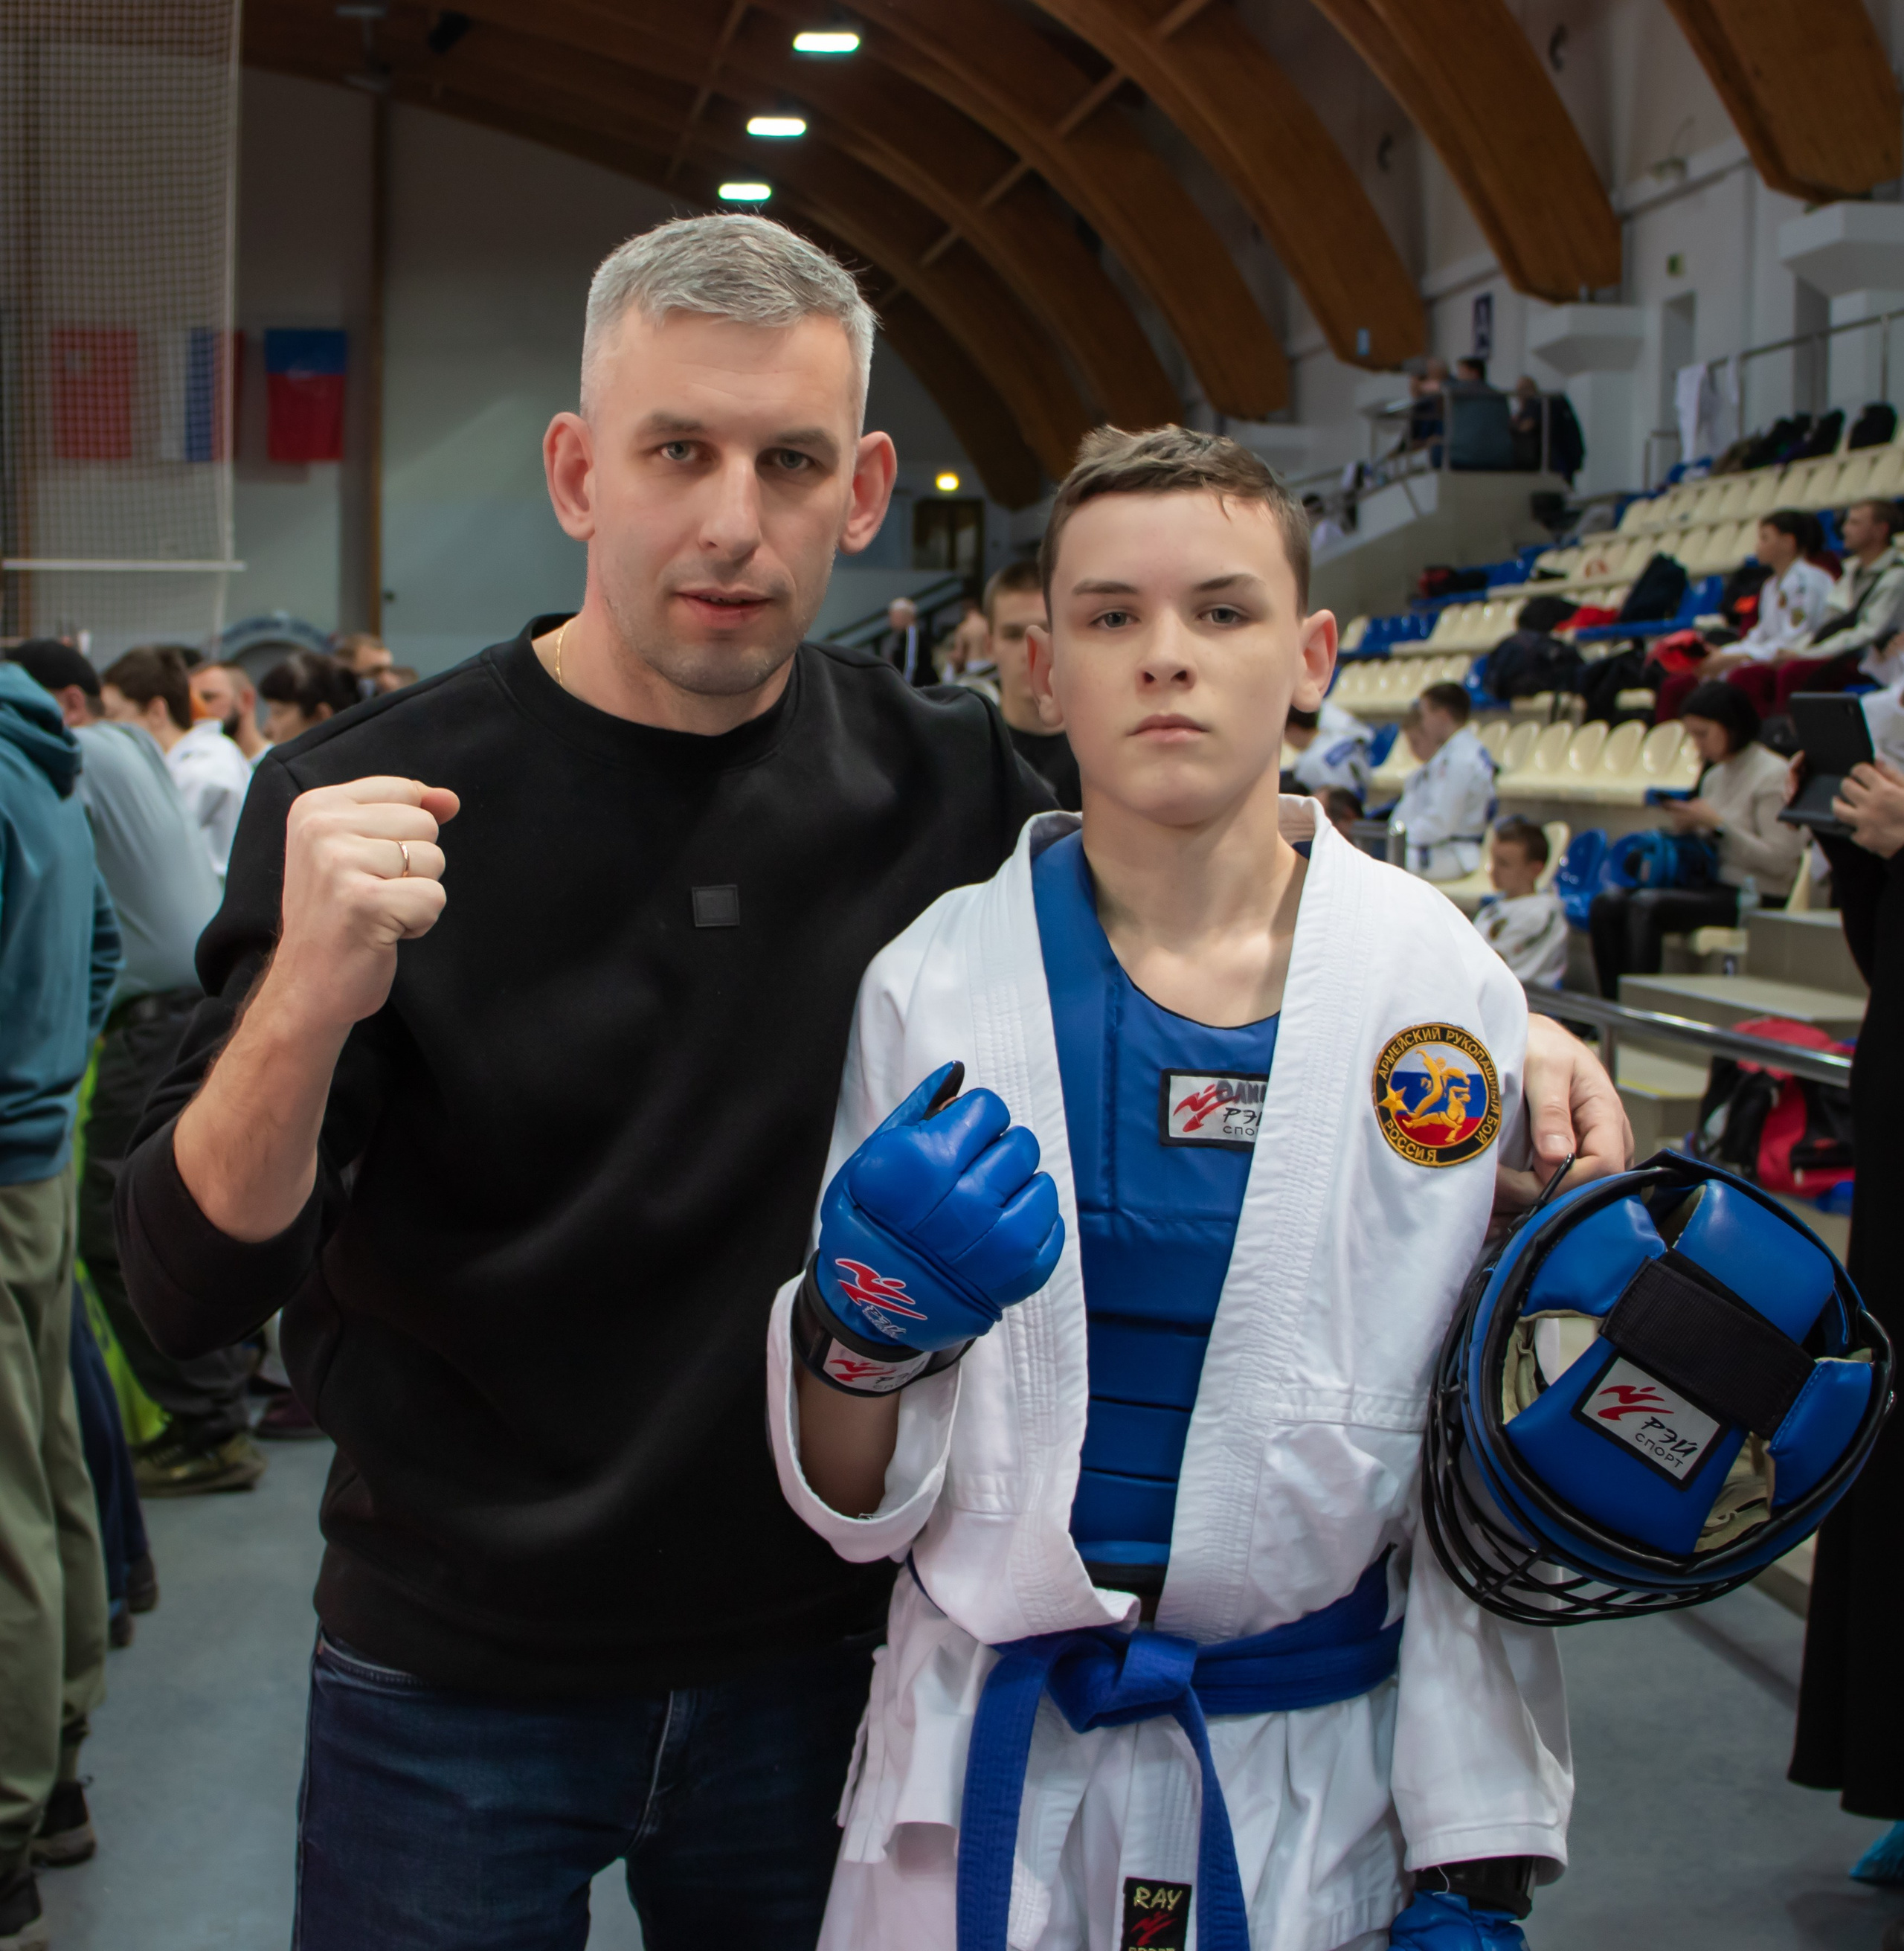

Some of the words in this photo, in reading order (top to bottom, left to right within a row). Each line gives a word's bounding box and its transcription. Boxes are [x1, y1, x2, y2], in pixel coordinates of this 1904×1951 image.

[1378, 1027, 1441, 1080] АРМЕЙСКИЙ
[1474, 1114, 1499, 1145] БОЙ
[1223, 1125, 1258, 1137] СПО
[1384, 1119, 1438, 1163] РОССИЯ
[1635, 1433, 1684, 1468] СПОРТ
[1641, 1415, 1698, 1458] РЭЙ
[1133, 1886, 1183, 1912] RAY
